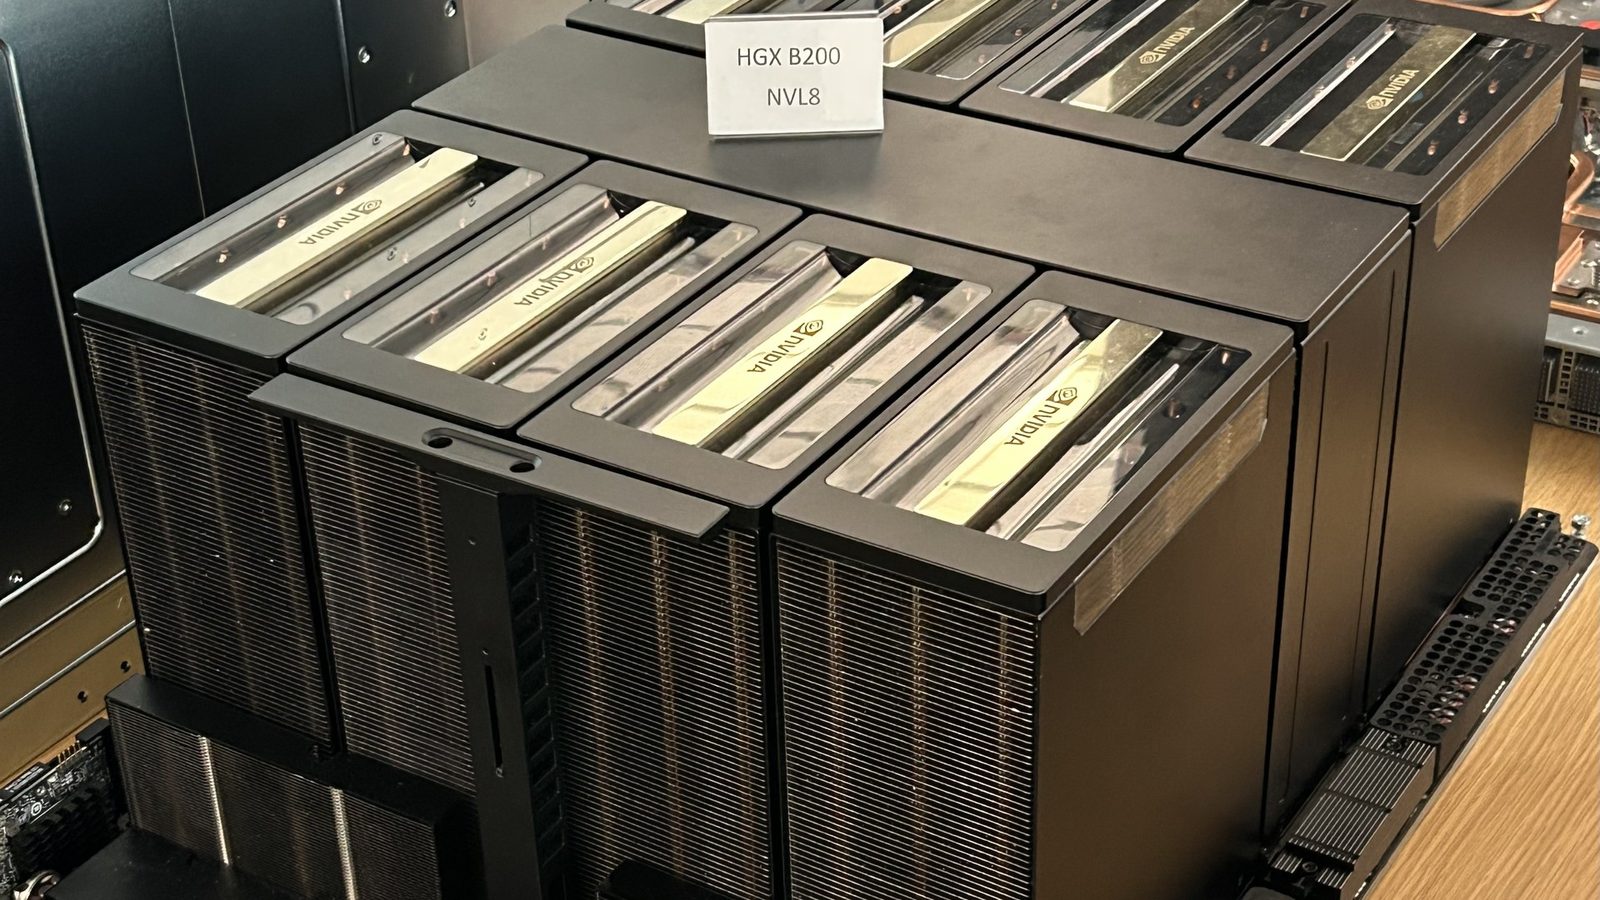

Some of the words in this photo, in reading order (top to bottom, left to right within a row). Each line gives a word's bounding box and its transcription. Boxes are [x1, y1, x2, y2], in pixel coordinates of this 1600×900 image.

[737, 47, 782, 66] HGX
[789, 46, 841, 66] B200
[767, 87, 821, 106] NVL8
